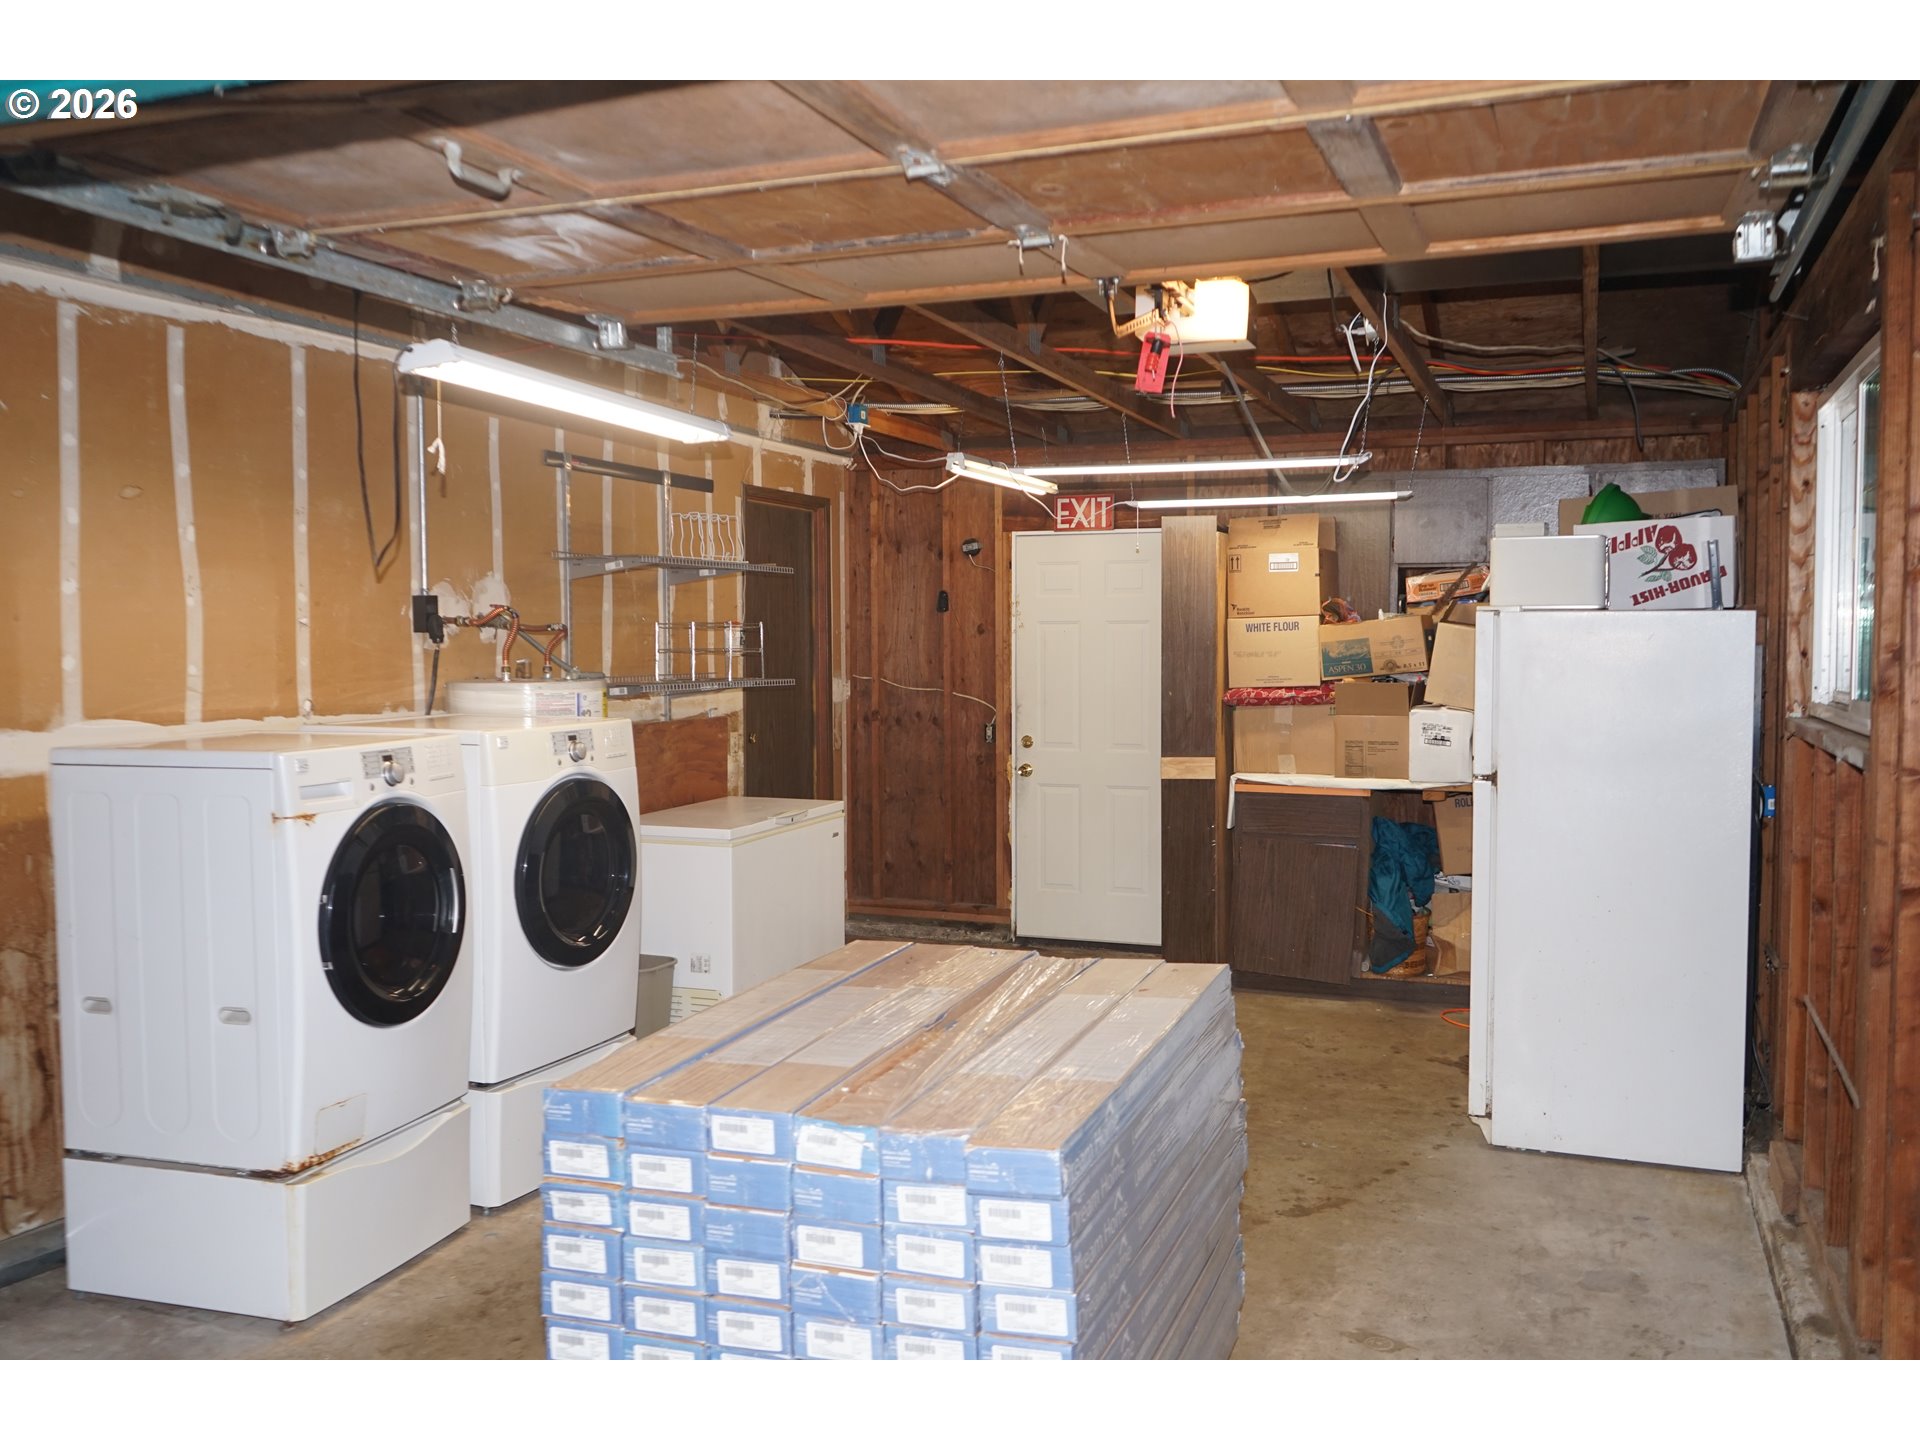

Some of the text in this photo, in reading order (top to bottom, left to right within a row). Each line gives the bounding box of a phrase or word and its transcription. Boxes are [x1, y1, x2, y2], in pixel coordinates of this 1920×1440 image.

[1056, 496, 1112, 529] EXIT
[1631, 565, 1728, 606] FAVOR-HIST
[1245, 621, 1300, 633] WHITE FLOUR
[1328, 663, 1354, 674] ASPEN
[1355, 662, 1367, 672] 30
[1100, 1157, 1125, 1200] Home
[1103, 1201, 1128, 1242] Home
